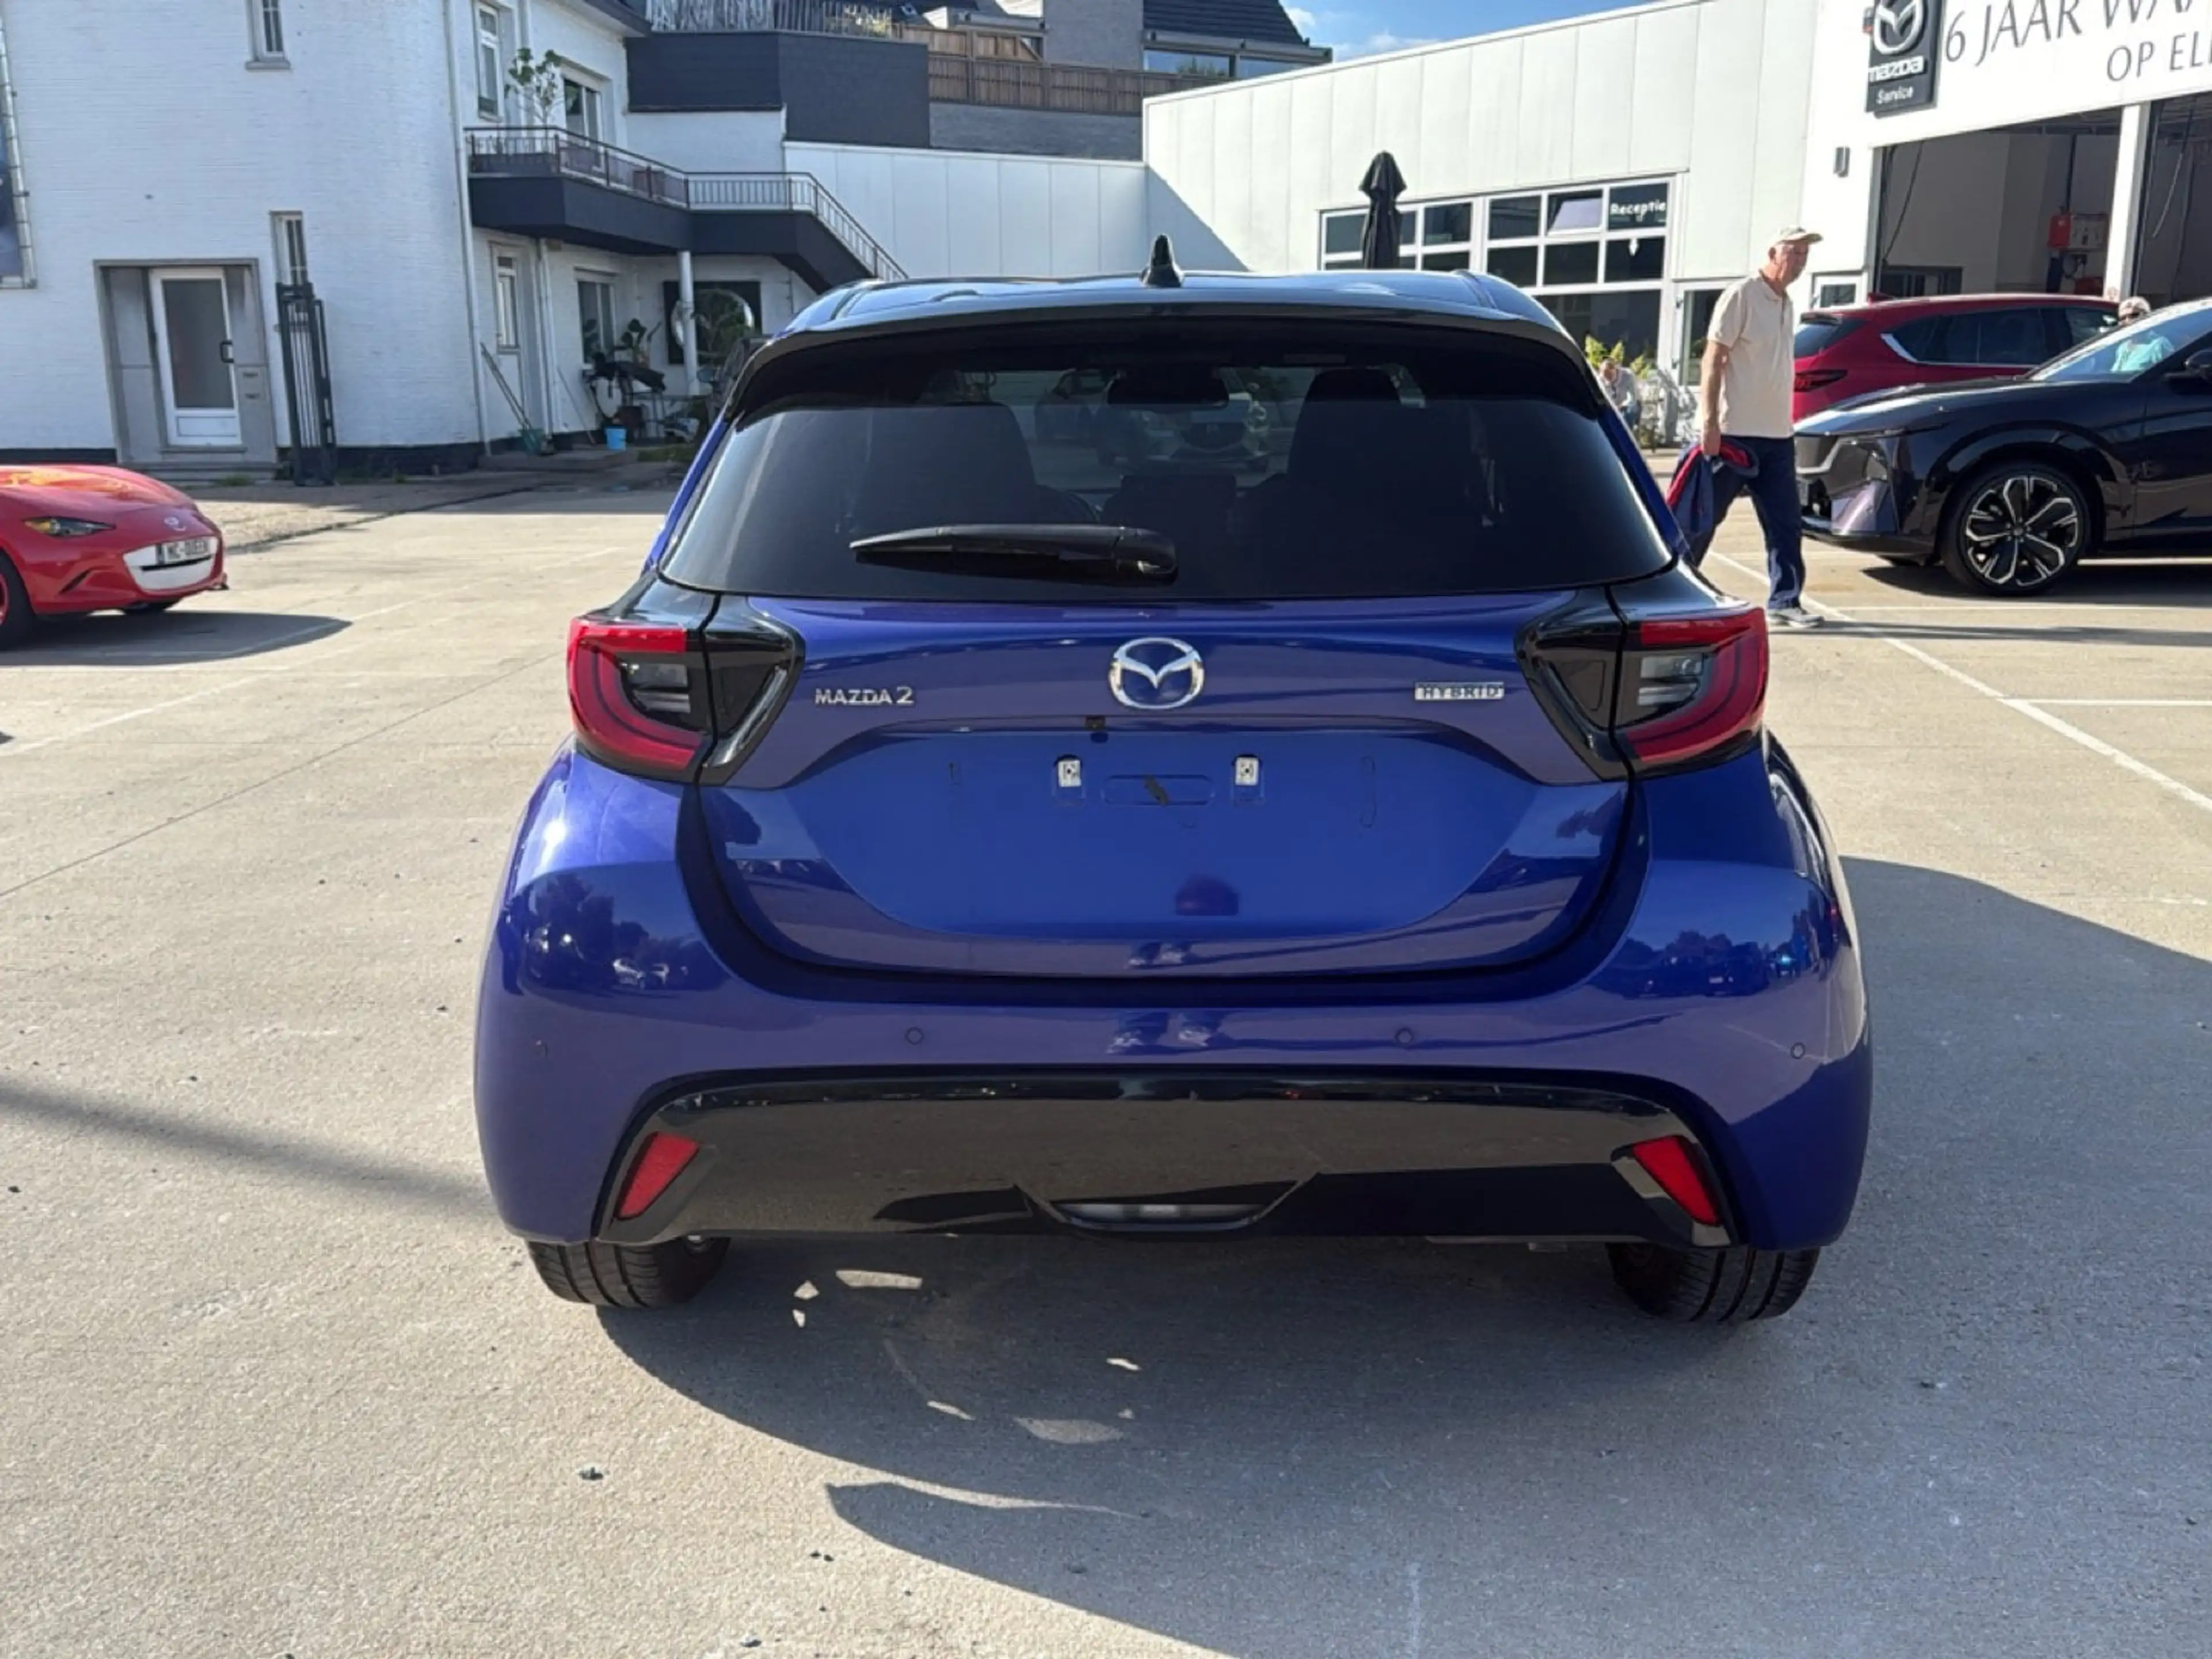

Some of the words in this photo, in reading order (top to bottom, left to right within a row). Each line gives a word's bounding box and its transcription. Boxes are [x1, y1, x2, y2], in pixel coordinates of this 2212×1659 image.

[1945, 10, 1966, 62] 6
[1974, 0, 2082, 67] JAAR
[2107, 44, 2155, 82] OP
[2169, 31, 2212, 71] EL
[1610, 199, 1666, 219] Receptie
[1416, 683, 1504, 701] HYBRID
